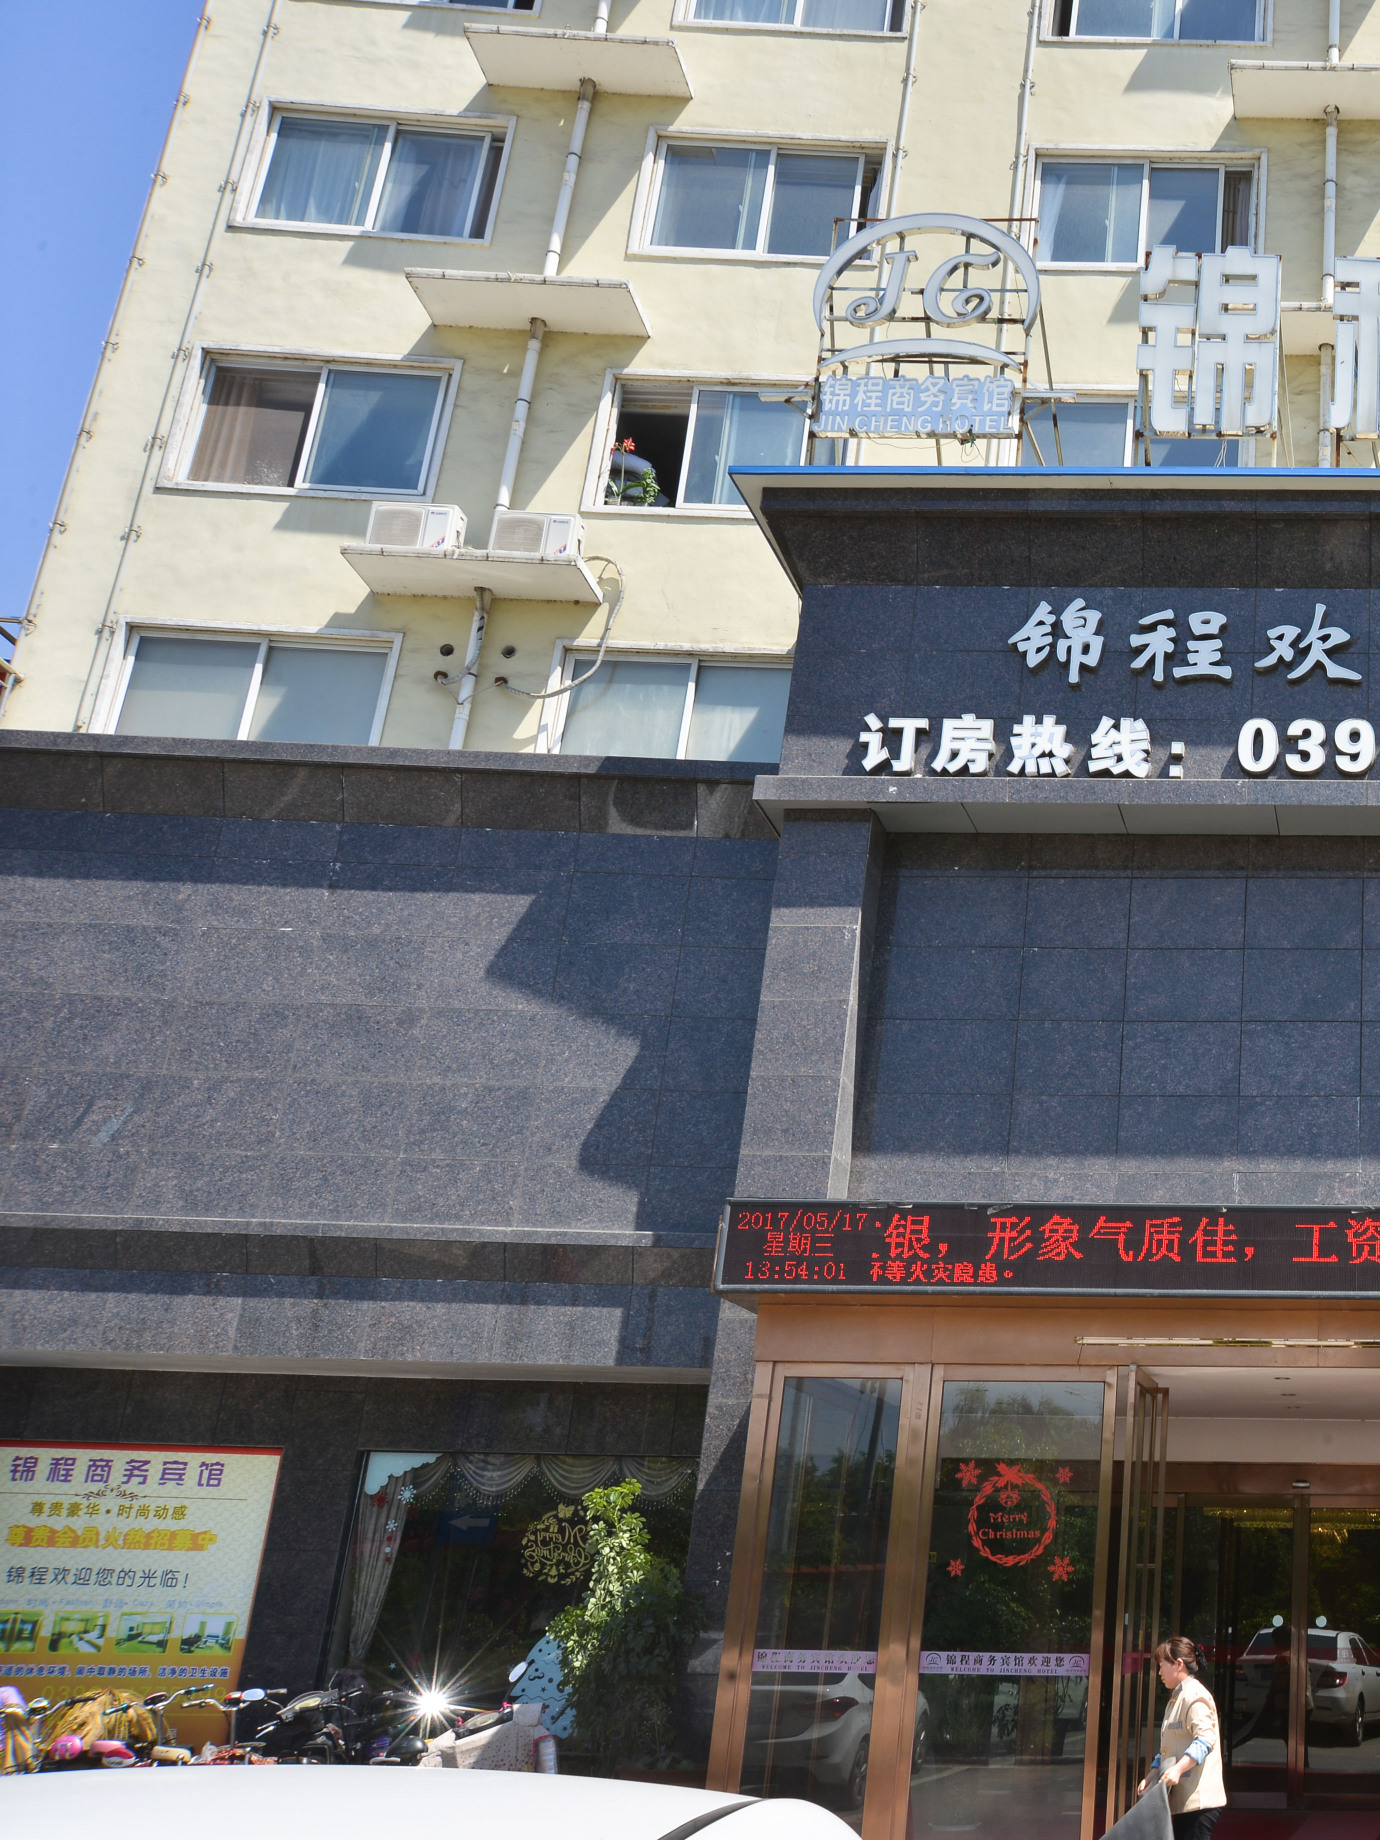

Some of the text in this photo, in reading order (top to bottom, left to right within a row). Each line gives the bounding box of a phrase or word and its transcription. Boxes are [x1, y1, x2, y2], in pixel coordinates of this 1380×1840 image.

[822, 376, 1011, 412] 锦程商务宾馆
[814, 415, 1012, 433] JIN CHENG HOTEL
[738, 1209, 868, 1232] 2017/05/17
[763, 1231, 835, 1257] 星期三
[744, 1260, 846, 1281] 13:54:01
[9, 1455, 226, 1488] 锦程商务宾馆
[989, 1512, 1028, 1524] Merry
[5, 1524, 218, 1552] 尊贵会员火热招募中
[978, 1528, 1041, 1540] Christmas
[946, 1653, 1065, 1668] 锦程商务宾馆欢迎您
